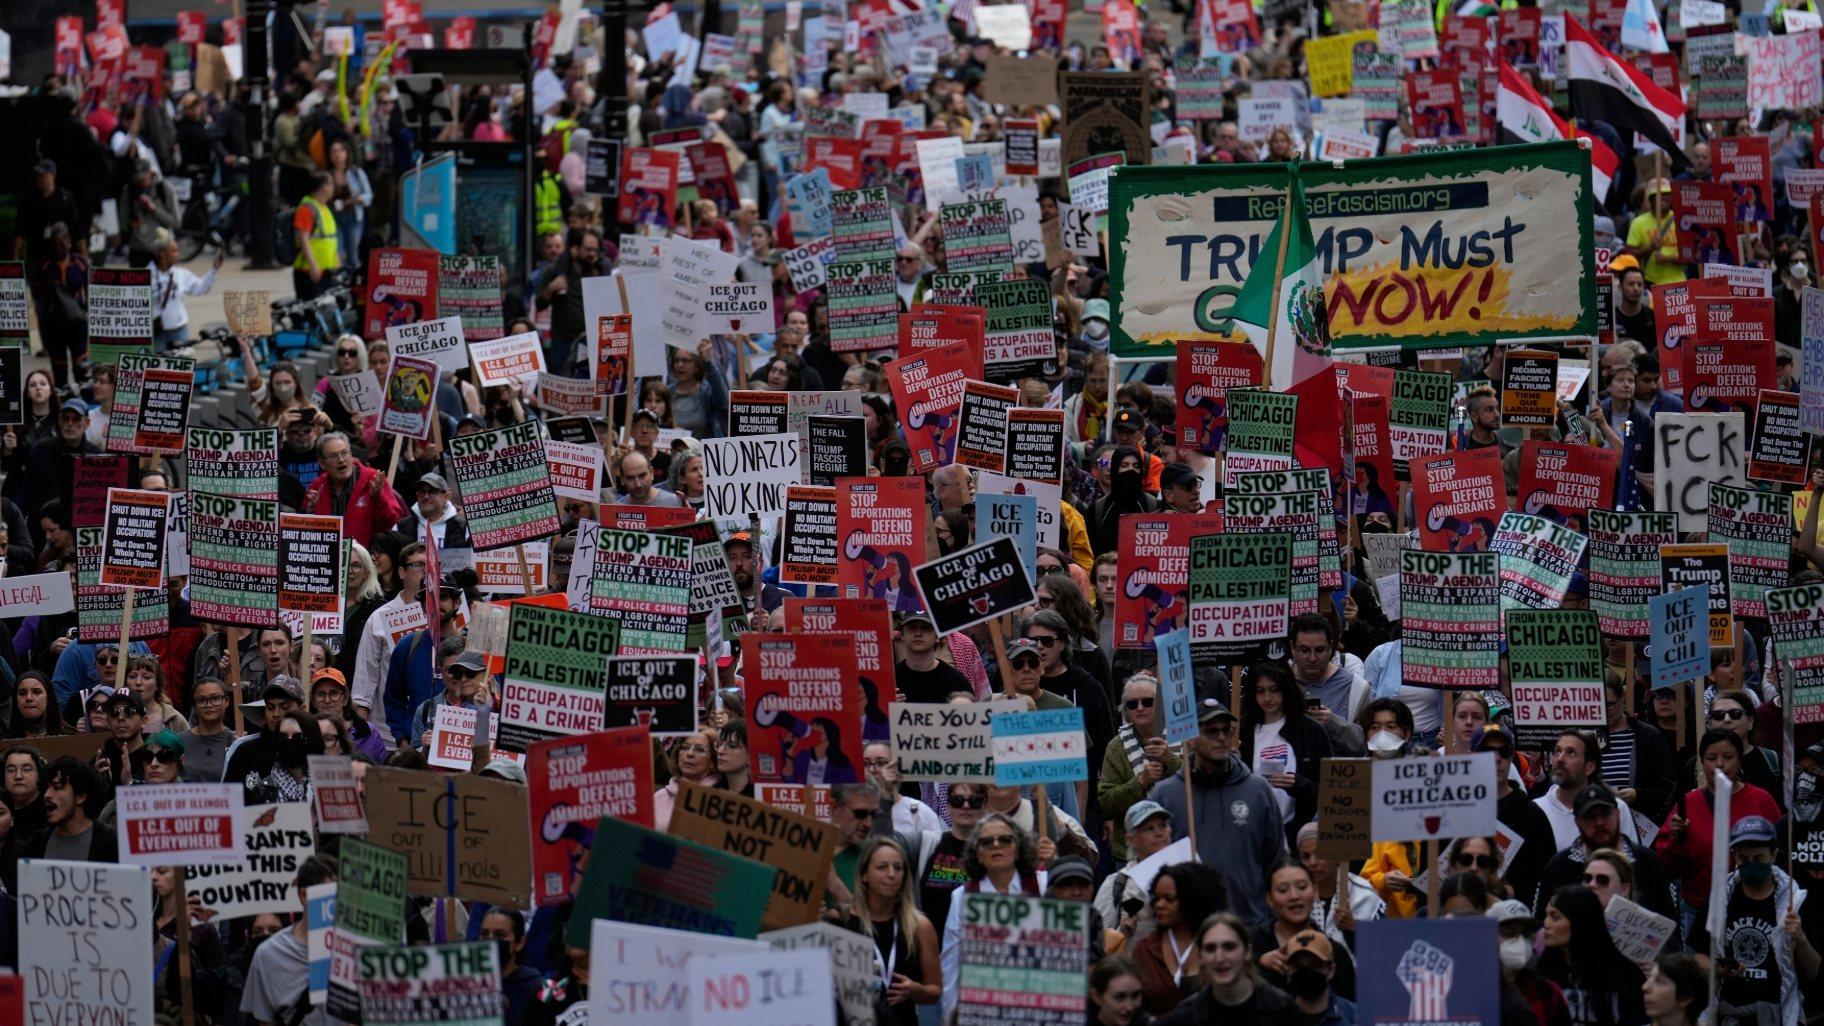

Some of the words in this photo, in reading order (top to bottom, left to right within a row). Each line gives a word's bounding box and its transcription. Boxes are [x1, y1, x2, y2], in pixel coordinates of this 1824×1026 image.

[1249, 190, 1450, 219] RefseFascism.org
[1400, 216, 1526, 271] Must
[90, 287, 127, 296] SUPPORT
[132, 288, 150, 296] THE
[710, 286, 731, 296] ICE
[734, 286, 757, 296] OUT
[1328, 269, 1494, 326] NOW!
[90, 299, 150, 308] REFERENDUM
[705, 301, 767, 312] CHICAGO
[91, 317, 111, 326] OVER
[115, 318, 150, 327] POLICE
[399, 327, 420, 338] ICE
[422, 322, 446, 334] OUT
[396, 336, 458, 354] CHICAGO
[418, 334, 429, 342] OF
[1696, 354, 1724, 365] STOP
[1696, 365, 1757, 374] DEPORTATIONS
[1508, 382, 1520, 390] DE
[1509, 374, 1550, 382] FASCISTA
[1717, 375, 1757, 386] DEFEND
[1697, 386, 1757, 396] IMMIGRANTS
[732, 405, 750, 414] SHUT
[751, 406, 770, 414] DOWN
[772, 406, 787, 414] ICE!
[740, 416, 749, 424] NO
[750, 416, 778, 425] MILITARY
[739, 425, 778, 434] OCCUPATION!
[812, 428, 827, 437] THE
[828, 429, 847, 438] FALL
[452, 433, 498, 458] STOP
[502, 423, 536, 446] THE
[1660, 422, 1738, 469] FCK
[813, 445, 842, 454] TRUMP
[703, 442, 738, 478] NO
[740, 440, 797, 473] NAZIS
[813, 454, 848, 464] FASCIST
[814, 463, 848, 472] REGIME
[707, 482, 736, 517] NO
[740, 482, 798, 514] KING
[851, 493, 878, 507] STOP
[851, 507, 912, 519] DEPORTATIONS
[872, 519, 912, 533] DEFEND
[599, 531, 649, 553] STOP
[656, 536, 690, 558] THE
[852, 533, 912, 546] IMMIGRANTS
[1194, 538, 1222, 548] FROM
[598, 552, 635, 564] TRUMP
[639, 555, 690, 570] AGENDA!
[936, 558, 964, 578] ICE
[965, 547, 996, 568] OUT
[1192, 548, 1288, 570] CHICAGO
[1683, 558, 1702, 568] The
[1275, 568, 1286, 577] TO
[1669, 568, 1722, 584] Trump
[934, 563, 1014, 601] CHICAGO
[1192, 580, 1287, 600] PALESTINE
[516, 608, 546, 621] FROM
[617, 600, 652, 611] POLICE
[655, 604, 688, 615] CRIMES
[1192, 604, 1285, 621] OCCUPATION
[1665, 597, 1694, 620] ICE
[1509, 613, 1536, 624] FROM
[1664, 615, 1694, 636] OUT
[1192, 623, 1206, 638] IS
[1214, 622, 1224, 637] A
[1233, 618, 1284, 636] CRIME!
[1510, 625, 1598, 646] CHICAGO
[512, 620, 614, 655] CHICAGO
[1673, 632, 1687, 645] OF
[761, 652, 796, 668] STOP
[1588, 649, 1598, 658] TO
[508, 658, 606, 689] PALESTINE
[617, 662, 642, 676] ICE
[644, 662, 677, 676] OUT
[761, 668, 842, 681] DEPORTATIONS
[1512, 662, 1600, 678] PALESTINE
[610, 684, 686, 700] CHICAGO
[789, 682, 842, 696] DEFEND
[1515, 688, 1602, 702] OCCUPATION
[506, 686, 604, 713] OCCUPATION
[763, 697, 844, 712] IMMIGRANTS
[505, 704, 521, 718] IS
[527, 706, 538, 722] A
[546, 710, 602, 732] CRIME!
[899, 710, 934, 726] ARE
[940, 710, 978, 727] YOU
[1518, 705, 1531, 720] IS
[1537, 705, 1548, 720] A
[1552, 705, 1602, 720] CRIME!
[1004, 718, 1030, 732] THE
[1034, 713, 1079, 730] WHOLE
[898, 733, 940, 750] WE'RE
[947, 734, 986, 751] STILL
[899, 756, 942, 777] LAND
[944, 762, 959, 776] OF
[964, 763, 982, 776] THE
[1022, 762, 1080, 778] WATCHING
[1394, 763, 1428, 779] ICE
[1434, 760, 1472, 776] OUT
[1424, 776, 1441, 786] OF
[1384, 785, 1487, 806] CHICAGO
[153, 800, 172, 810] OUT
[190, 798, 230, 809] ILLINOIS
[398, 787, 490, 834] ICE
[174, 818, 202, 834] OUT
[204, 818, 220, 833] OF
[684, 788, 822, 852] LIBERATION
[138, 834, 222, 850] EVERYWHERE
[246, 831, 312, 850] RANTS
[392, 833, 425, 847] OUT
[464, 836, 484, 849] OF
[724, 832, 773, 860] NOT
[247, 855, 296, 873] THIS
[47, 866, 110, 894] DUE
[23, 894, 138, 930] PROCESS
[967, 898, 1030, 926] STOP
[1040, 902, 1083, 930] THE
[67, 932, 101, 966] IS
[361, 949, 428, 978] STOP
[438, 948, 492, 974] THE
[32, 966, 82, 1000] DUE
[91, 968, 131, 1006] TO
[704, 974, 750, 1011] NO
[759, 968, 803, 1004] ICE
